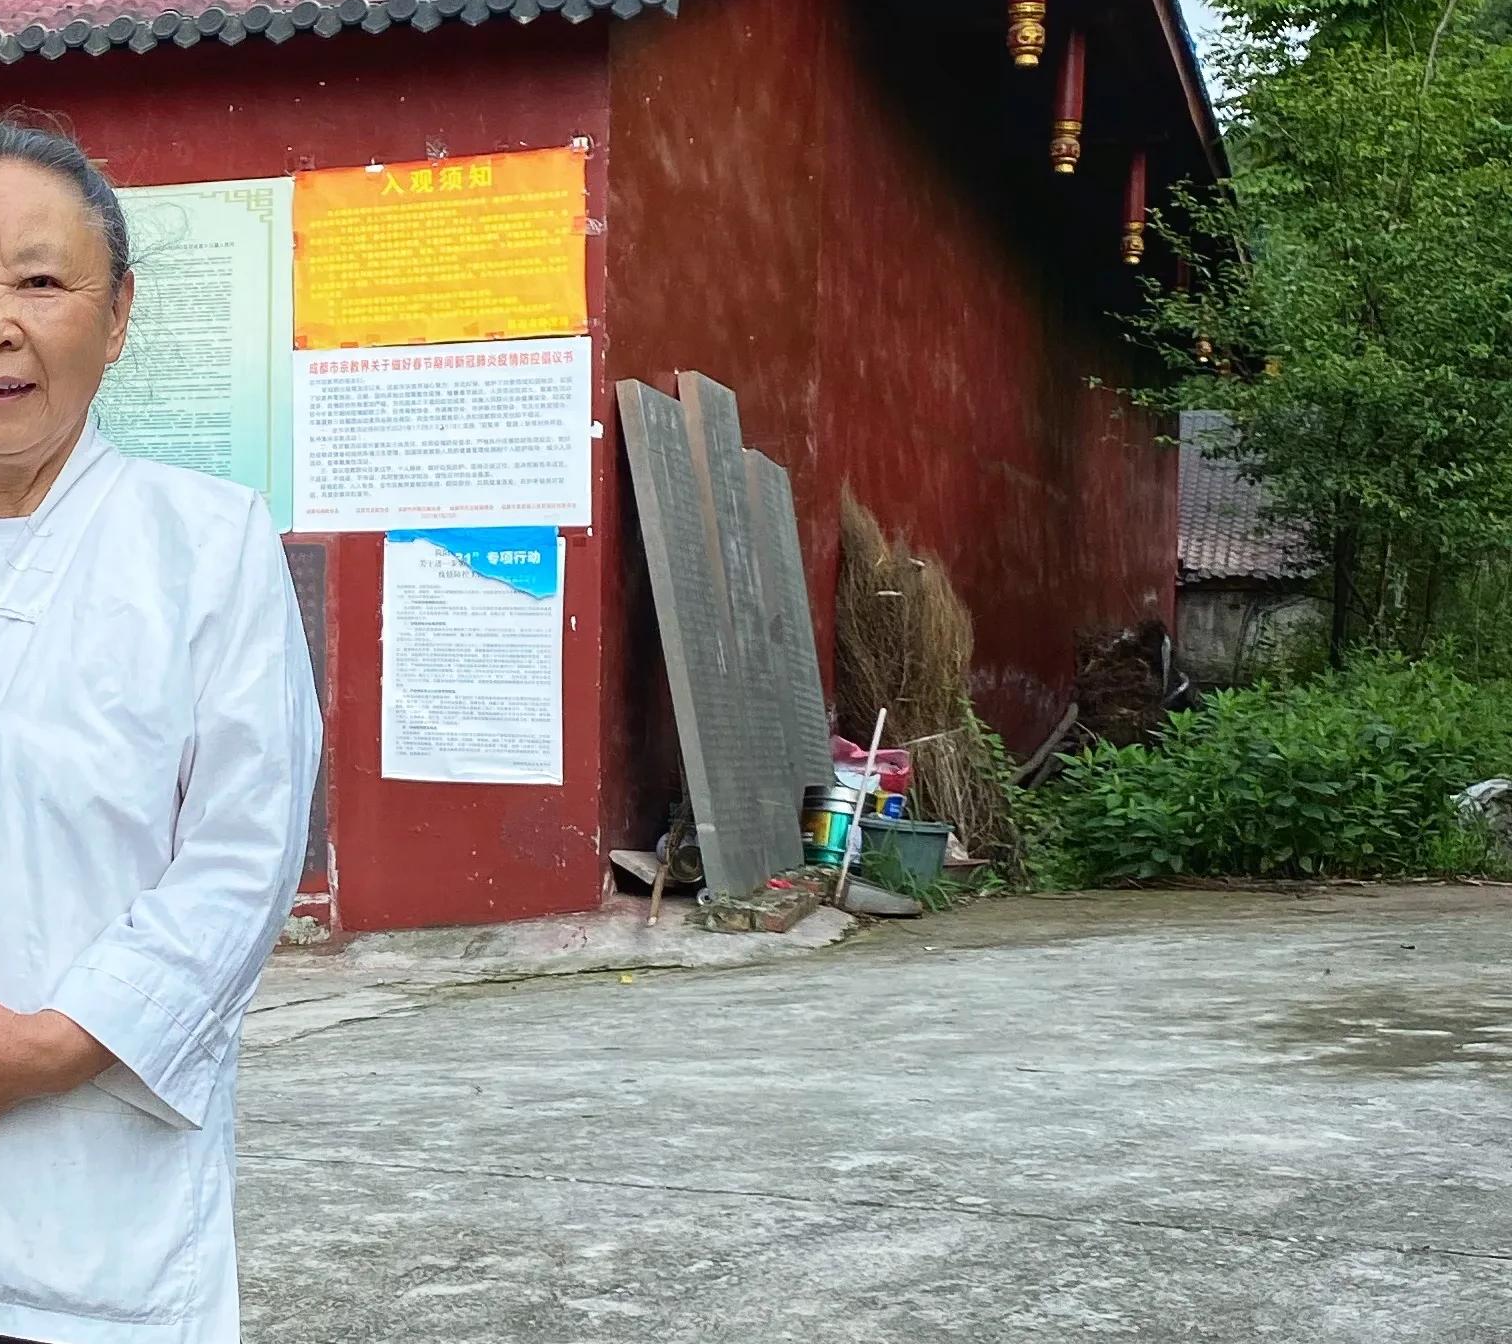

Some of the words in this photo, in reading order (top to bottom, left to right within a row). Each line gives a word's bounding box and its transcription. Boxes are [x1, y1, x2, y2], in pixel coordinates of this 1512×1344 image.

[381, 164, 494, 196] 入观须知
[487, 549, 542, 566] 专项行动
